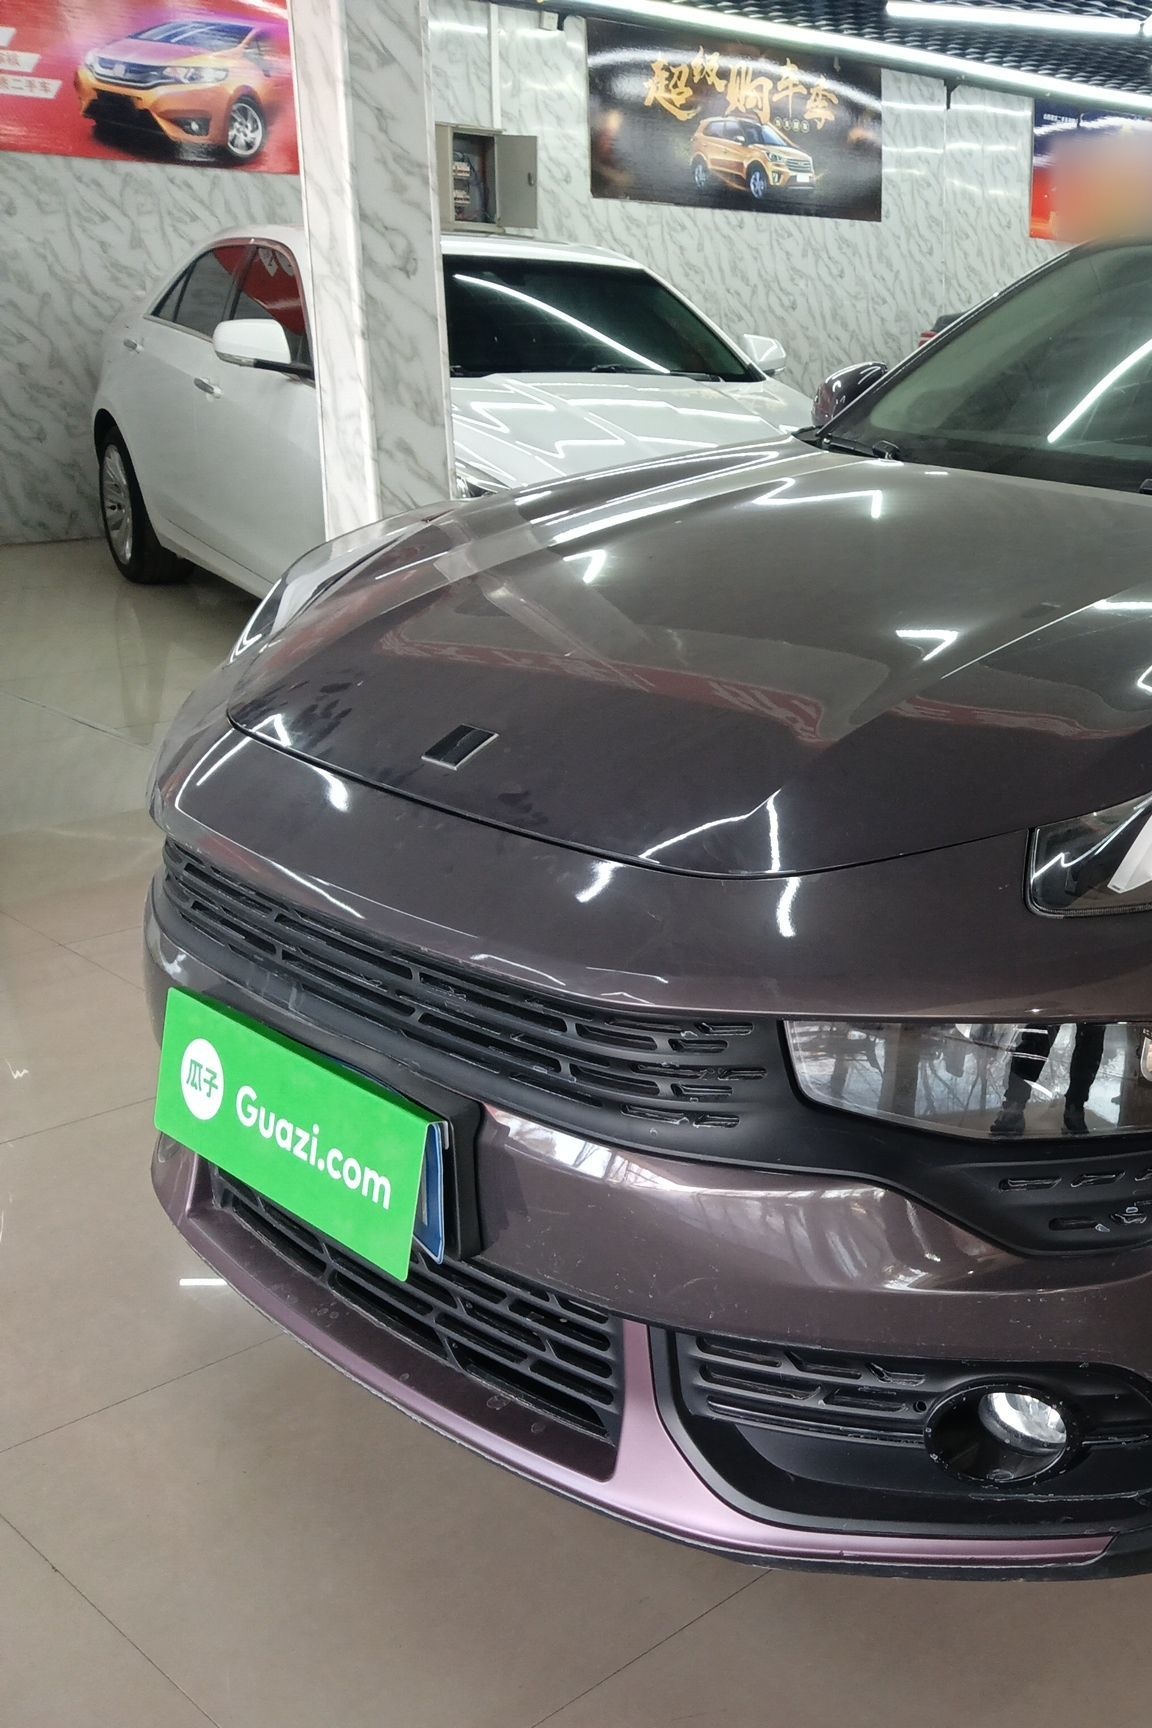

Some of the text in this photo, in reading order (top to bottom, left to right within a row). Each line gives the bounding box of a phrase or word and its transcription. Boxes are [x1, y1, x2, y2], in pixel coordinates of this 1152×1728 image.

[643, 46, 839, 130] 超级购车季
[186, 1059, 392, 1210] 瓜子 Guazi.com
